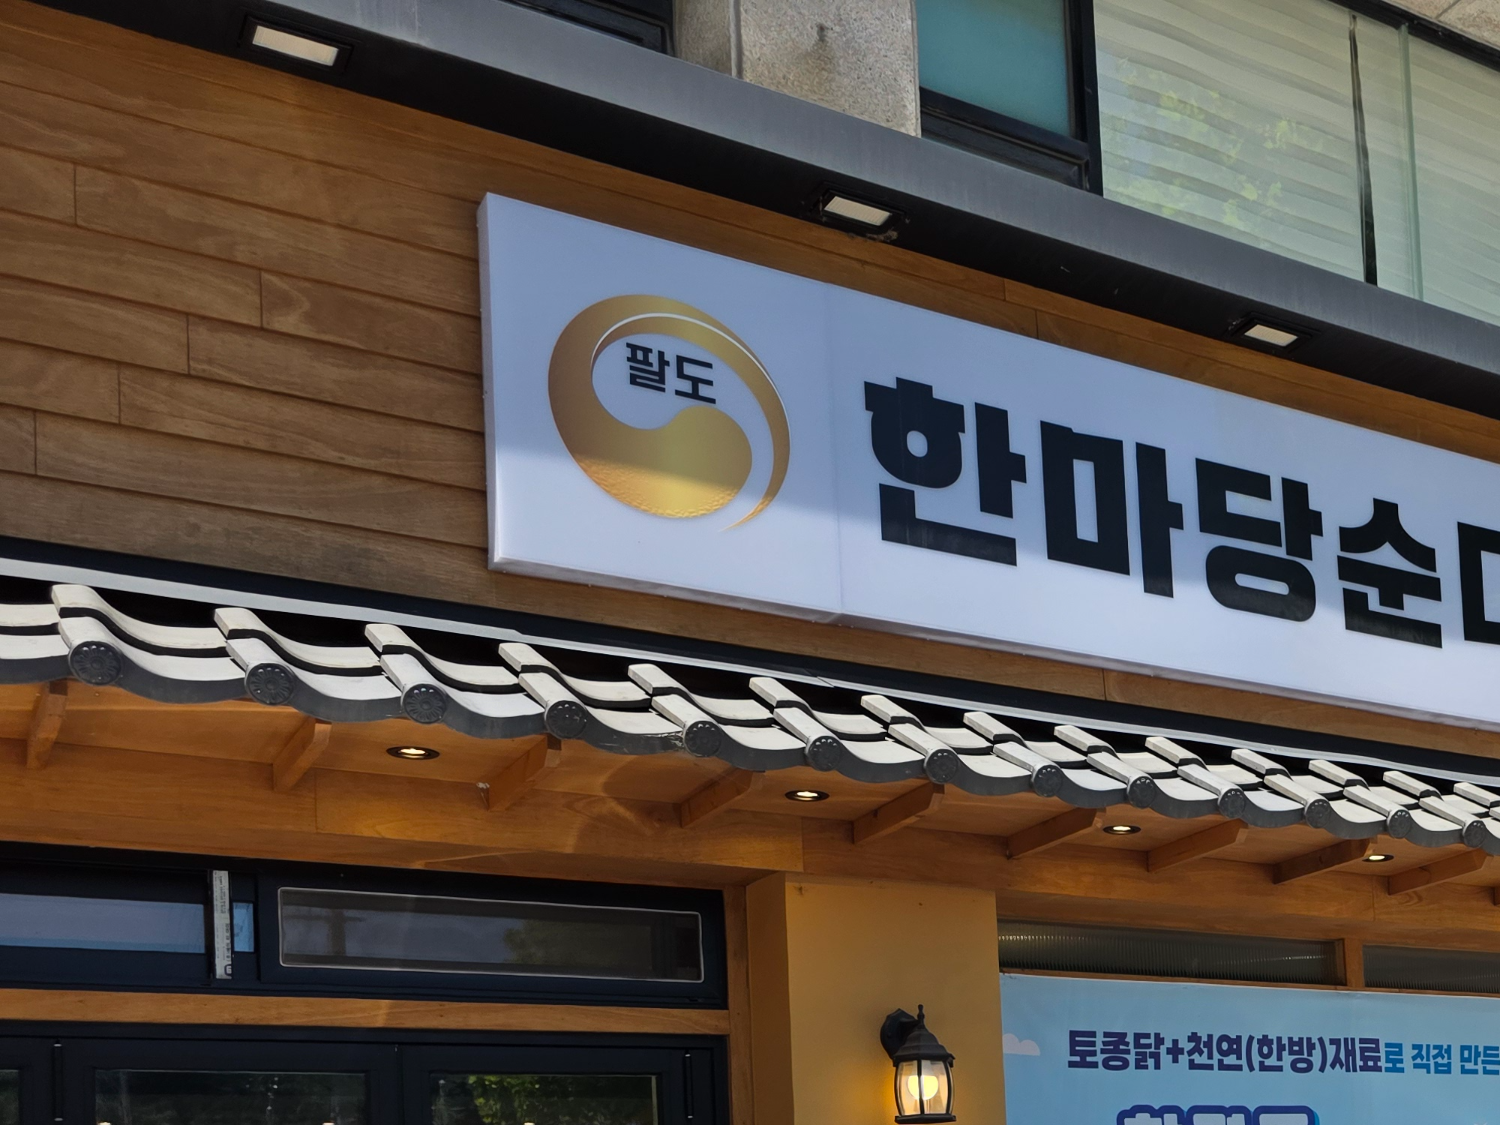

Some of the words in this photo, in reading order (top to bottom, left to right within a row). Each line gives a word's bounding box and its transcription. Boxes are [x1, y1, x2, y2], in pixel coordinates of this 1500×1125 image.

[626, 341, 717, 404] 팔도
[1068, 1030, 1405, 1073] 토종닭+천연(한방)재료로
[1411, 1043, 1452, 1075] 직접
[1459, 1044, 1500, 1075] 만든
